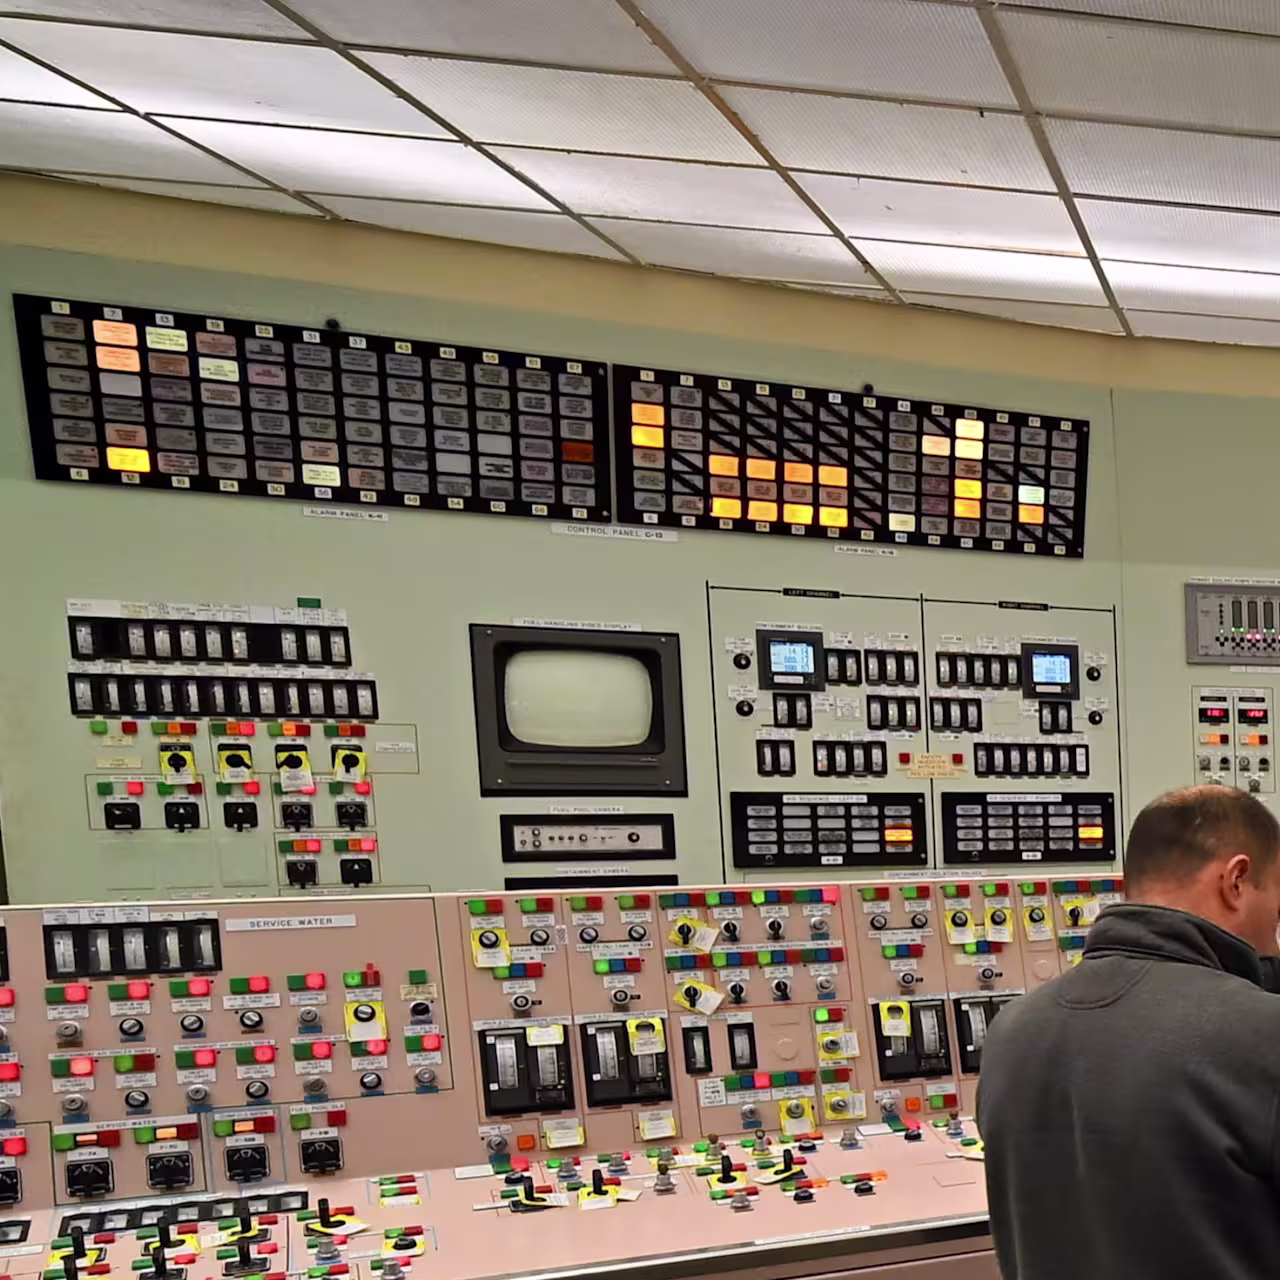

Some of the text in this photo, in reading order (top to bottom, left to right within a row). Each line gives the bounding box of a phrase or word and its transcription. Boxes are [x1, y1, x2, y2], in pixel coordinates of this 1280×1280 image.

[340, 511, 364, 519] PANEL
[567, 524, 663, 539] CONTROL PANEL C-13
[249, 917, 333, 929] SERVICE WATER
[95, 1119, 158, 1130] SERVICE WATER
